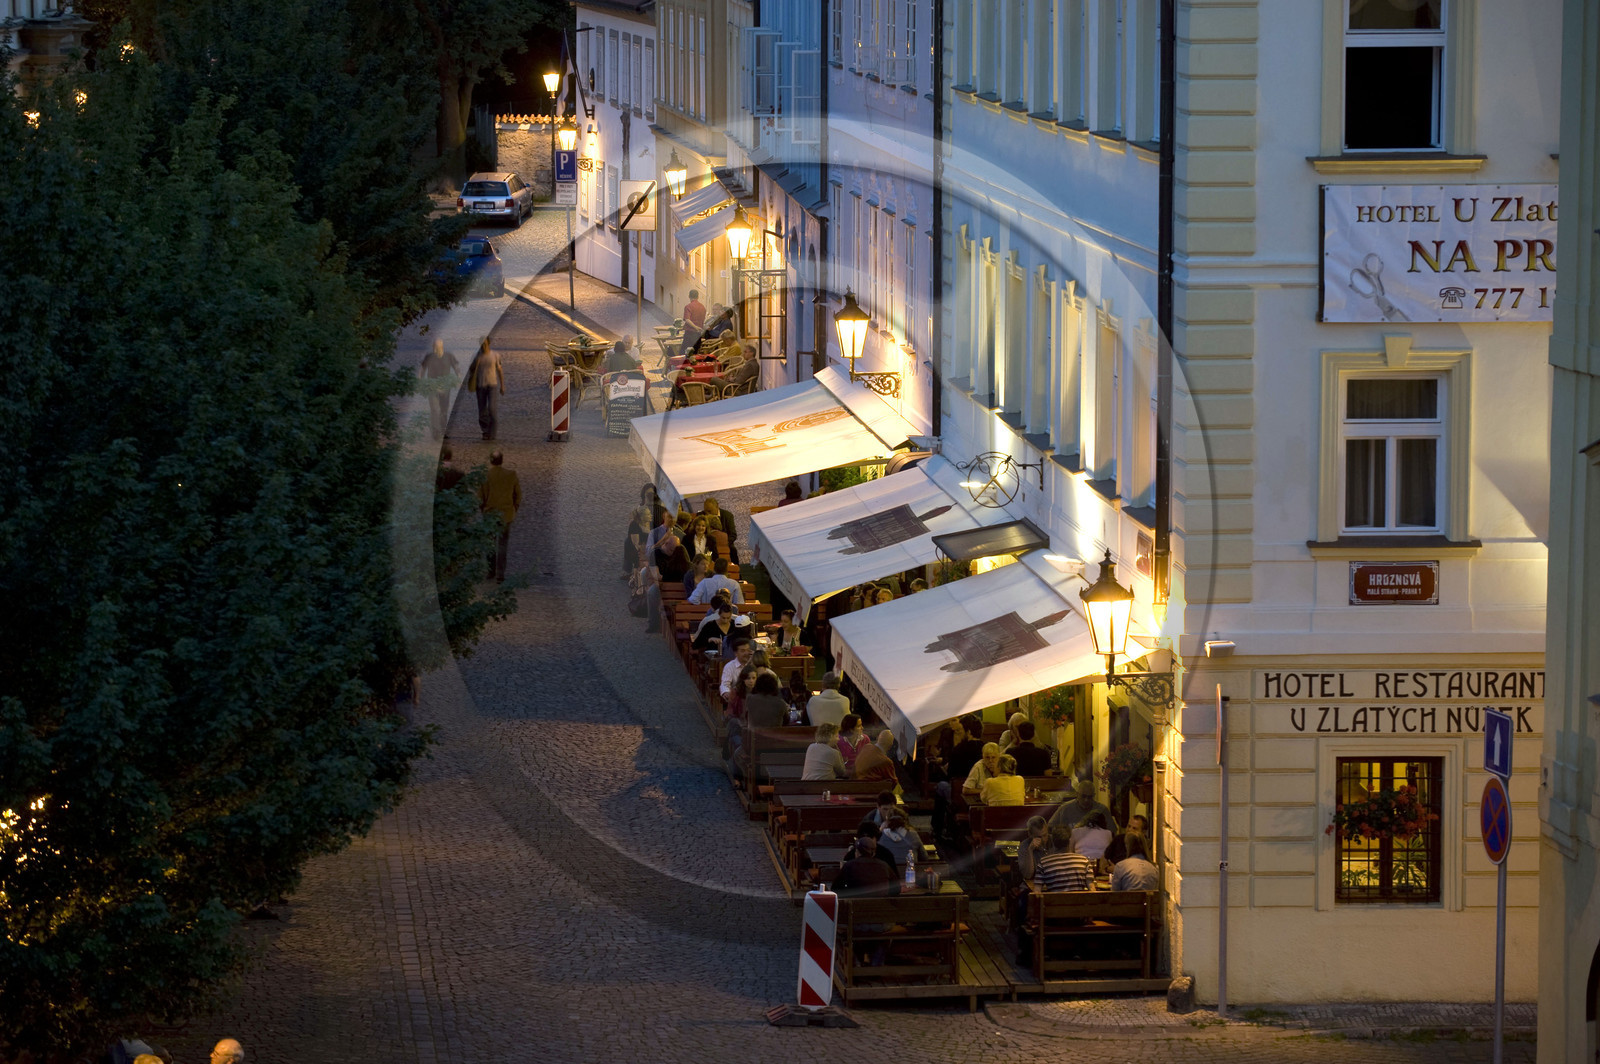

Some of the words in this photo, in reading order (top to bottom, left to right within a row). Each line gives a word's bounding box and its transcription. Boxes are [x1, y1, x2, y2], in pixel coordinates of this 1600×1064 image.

[560, 153, 569, 170] P
[1356, 205, 1441, 223] HOTEL
[1452, 197, 1480, 222] U
[1490, 196, 1559, 222] Zlat
[1407, 239, 1481, 273] NA
[1493, 239, 1557, 272] PR
[1474, 287, 1525, 309] 777
[1537, 286, 1557, 309] 1
[1369, 572, 1421, 585] HROZNOVÁ
[1264, 673, 1354, 698] HOTEL
[1375, 671, 1546, 699] RESTAURANT
[1290, 707, 1306, 732] U
[1316, 705, 1436, 733] ZLATÝCH
